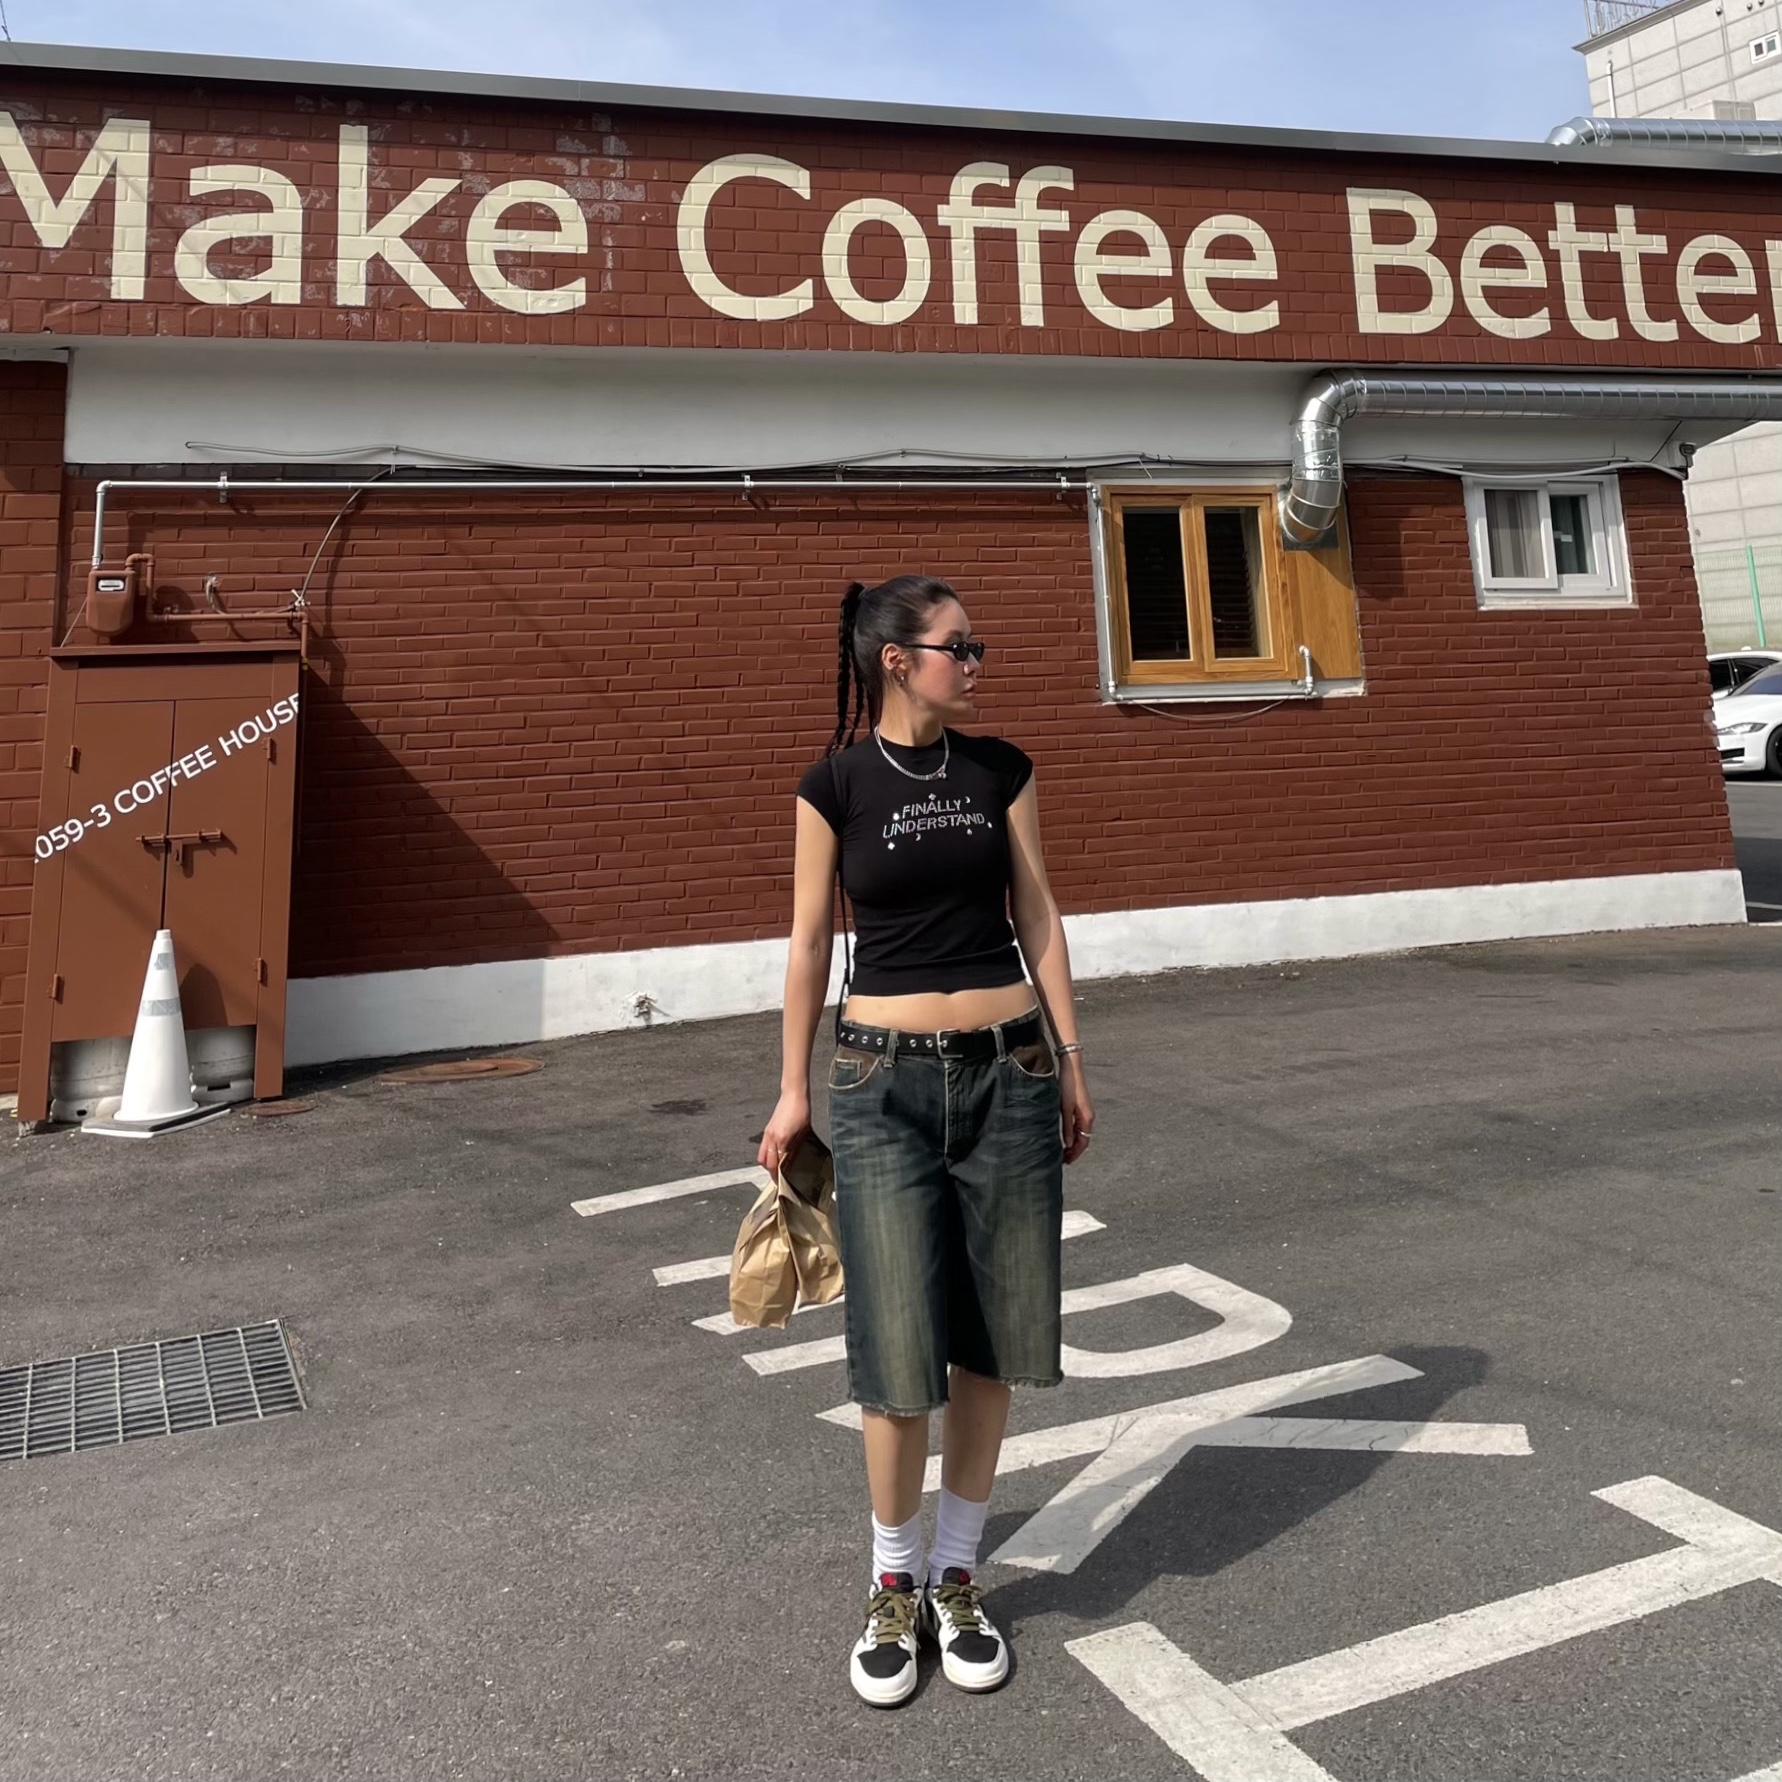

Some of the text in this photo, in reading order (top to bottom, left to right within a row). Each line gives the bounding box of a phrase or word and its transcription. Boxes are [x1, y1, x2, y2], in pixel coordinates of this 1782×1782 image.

[0, 111, 589, 314] Make
[676, 153, 1282, 335] Coffee
[34, 804, 111, 864] 059-3
[114, 744, 217, 814] COFFEE
[882, 812, 985, 839] UNDERSTAND
[902, 799, 961, 819] FINALLY
